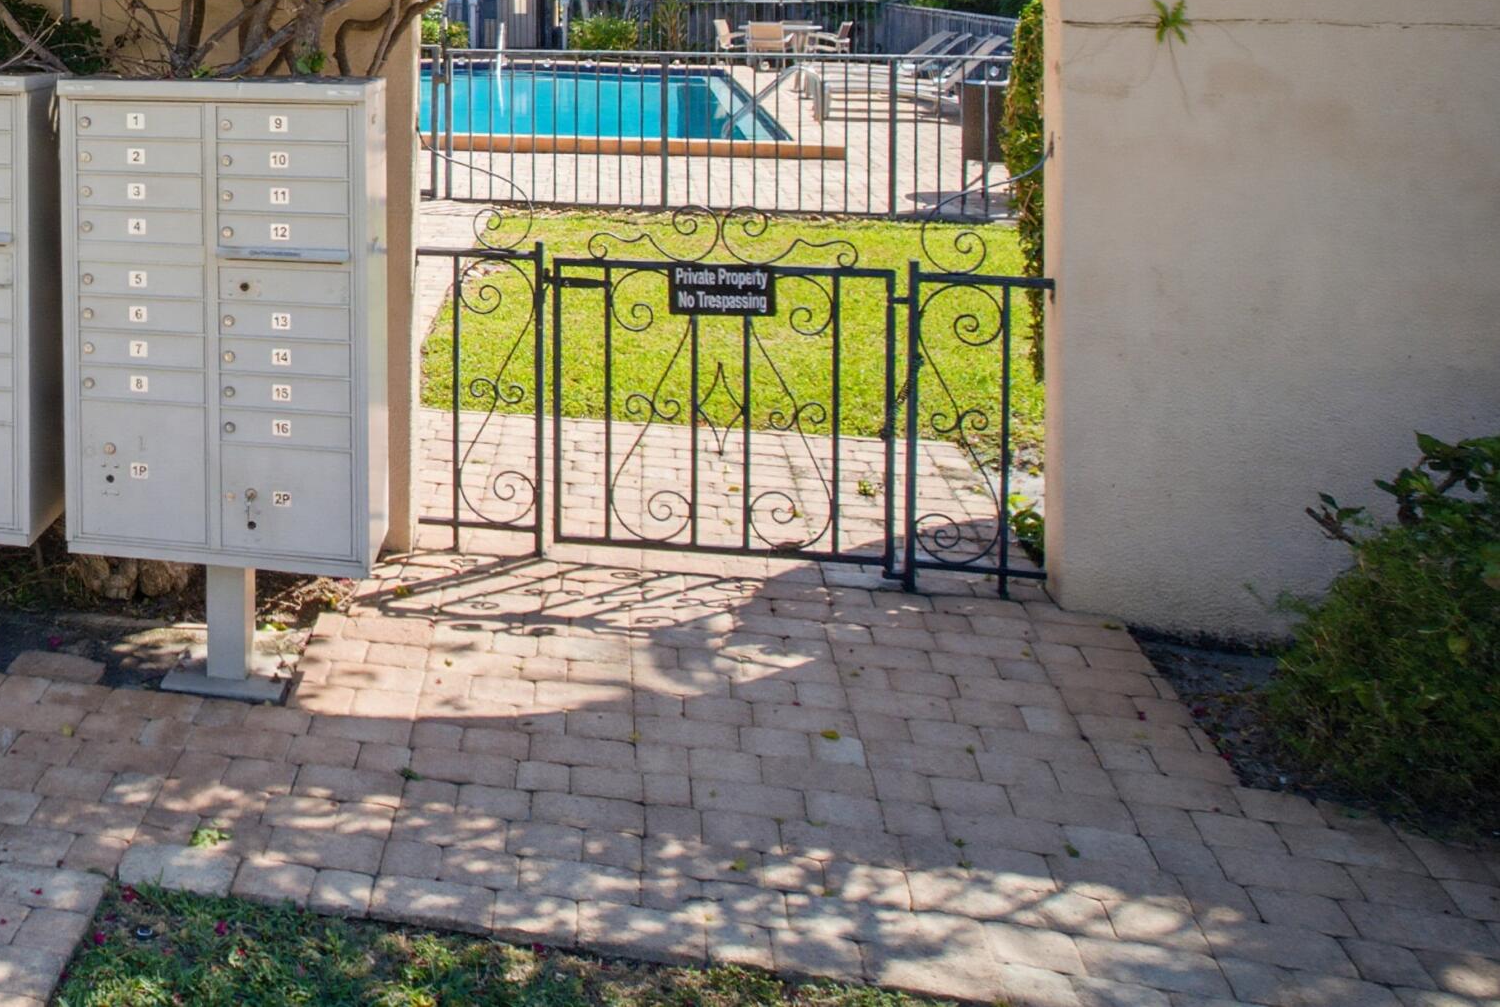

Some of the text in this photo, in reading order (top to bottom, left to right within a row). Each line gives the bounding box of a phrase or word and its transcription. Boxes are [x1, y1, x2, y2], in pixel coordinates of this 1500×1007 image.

[271, 154, 286, 166] 10
[273, 190, 286, 201] 11
[273, 226, 288, 238] 12
[675, 267, 768, 289] Private Property
[678, 291, 768, 313] No Trespassing
[274, 315, 288, 328] 13
[275, 352, 288, 362] 14
[275, 387, 289, 399] 15
[275, 422, 289, 434] 16
[132, 465, 148, 476] 1P
[275, 493, 291, 505] 2P
